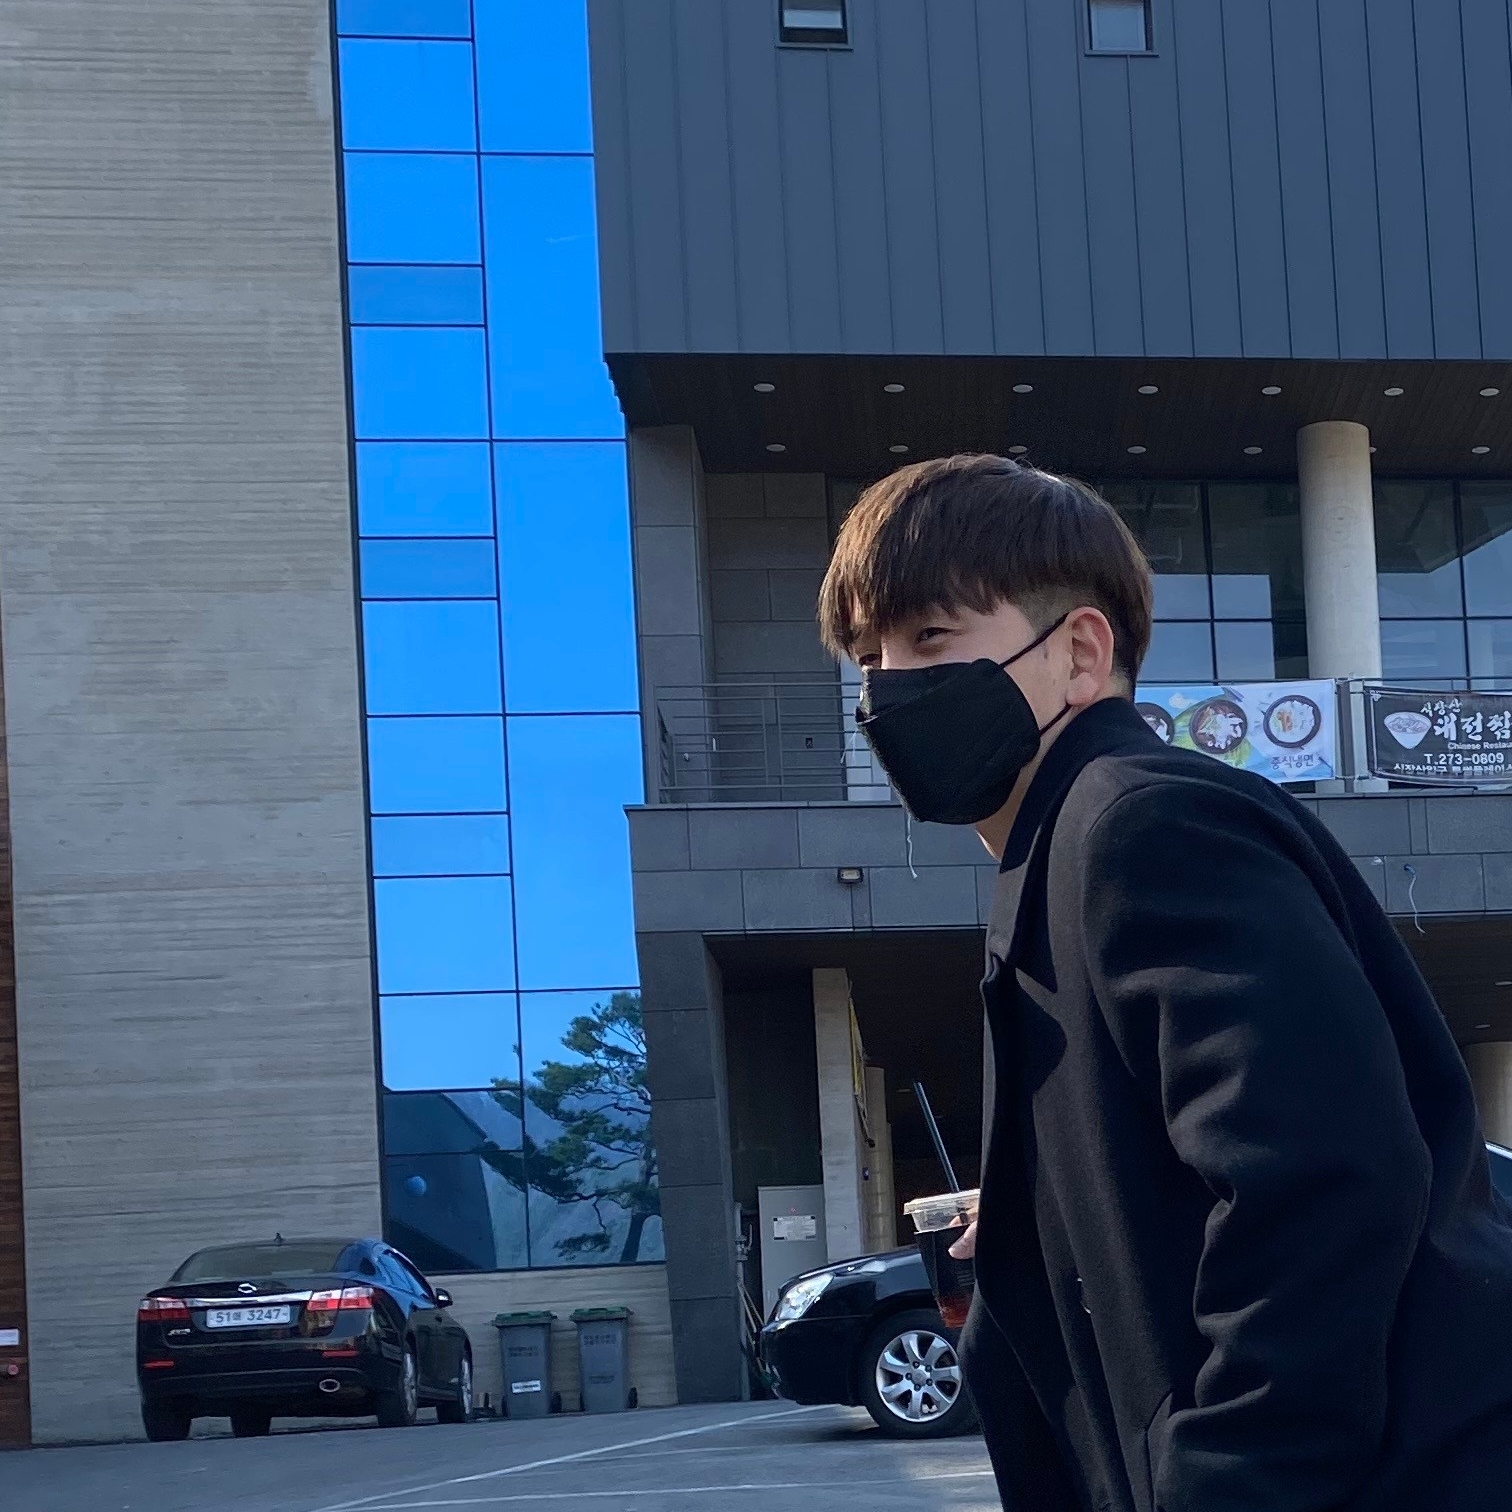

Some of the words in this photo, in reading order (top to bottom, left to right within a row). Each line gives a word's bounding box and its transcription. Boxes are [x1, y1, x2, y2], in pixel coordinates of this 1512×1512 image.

[1447, 741, 1482, 751] Chinese
[1423, 752, 1505, 766] T.273-0809
[247, 1307, 281, 1322] 3247
